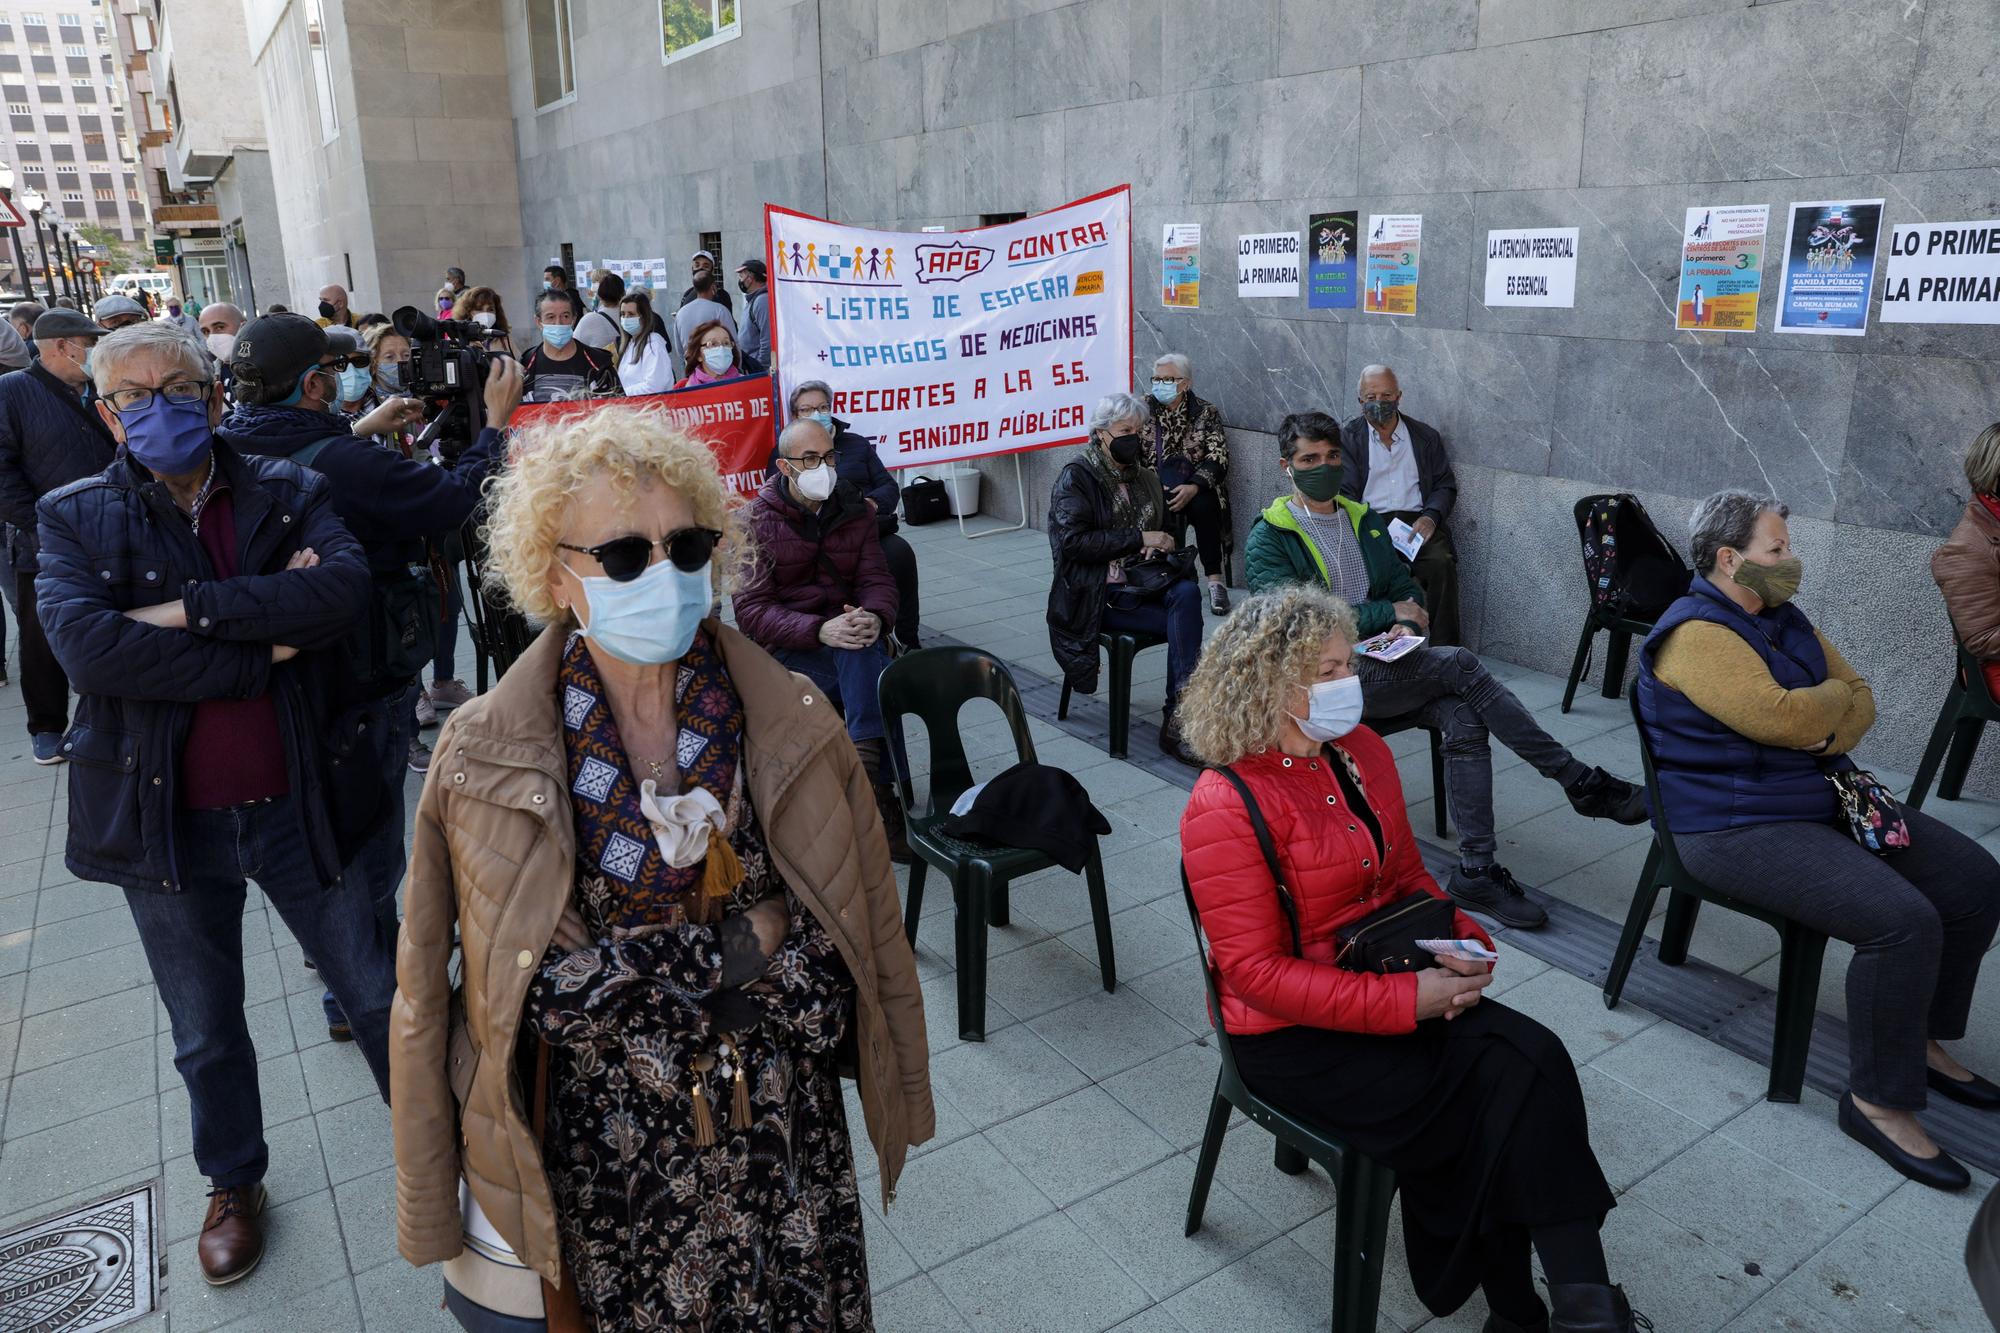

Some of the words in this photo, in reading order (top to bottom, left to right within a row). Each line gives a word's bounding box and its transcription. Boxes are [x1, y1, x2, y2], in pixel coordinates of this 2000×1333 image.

[929, 250, 980, 273] APG
[1008, 221, 1107, 261] CONTRA
[1240, 240, 1250, 255] LO
[1254, 236, 1299, 254] PRIMERO:
[1489, 239, 1497, 258] LA
[1532, 238, 1574, 258] PRESENCIAL
[1891, 231, 1920, 256] LO
[1926, 228, 2000, 256] PRIME
[1186, 256, 1194, 267] 3
[1400, 253, 1410, 265] 3
[1695, 254, 1726, 263] primero:
[1735, 254, 1749, 270] 3
[1240, 268, 1250, 284] LA
[1252, 267, 1298, 284] PRIMARIA
[1506, 276, 1516, 295] ES
[1516, 276, 1548, 296] ESENCIAL
[1884, 278, 1910, 302] LA
[932, 295, 962, 318] DE
[980, 275, 1069, 312] ESPERA
[830, 338, 948, 367] COPAGOS
[960, 333, 987, 358] DE
[833, 382, 955, 414] RECORTES
[974, 378, 986, 400] A
[1004, 370, 1032, 394] LA
[1052, 361, 1089, 386] S.S.
[750, 398, 770, 418] DE
